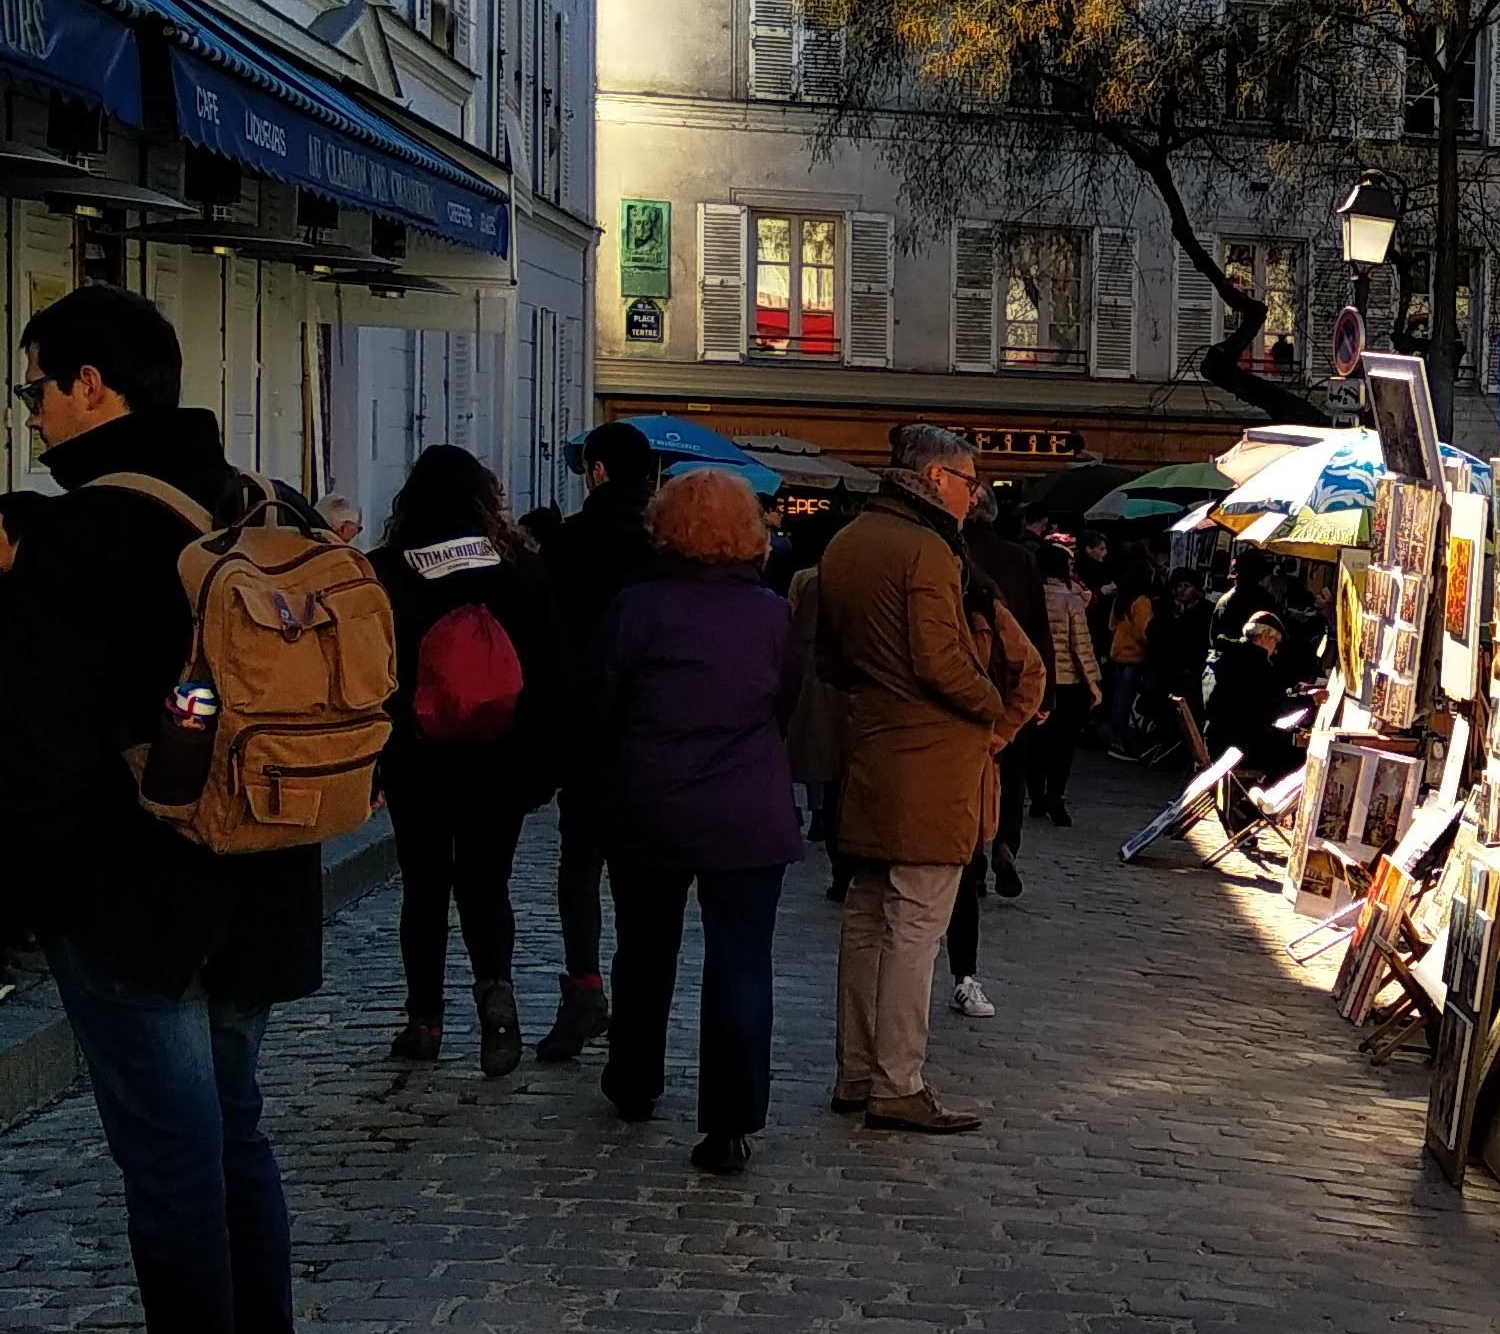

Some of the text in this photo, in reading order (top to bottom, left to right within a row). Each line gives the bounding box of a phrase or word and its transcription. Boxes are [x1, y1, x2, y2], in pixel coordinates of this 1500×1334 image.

[245, 109, 287, 157] LIQUEURS
[633, 315, 656, 323] PLACE
[631, 328, 658, 337] TERTRE
